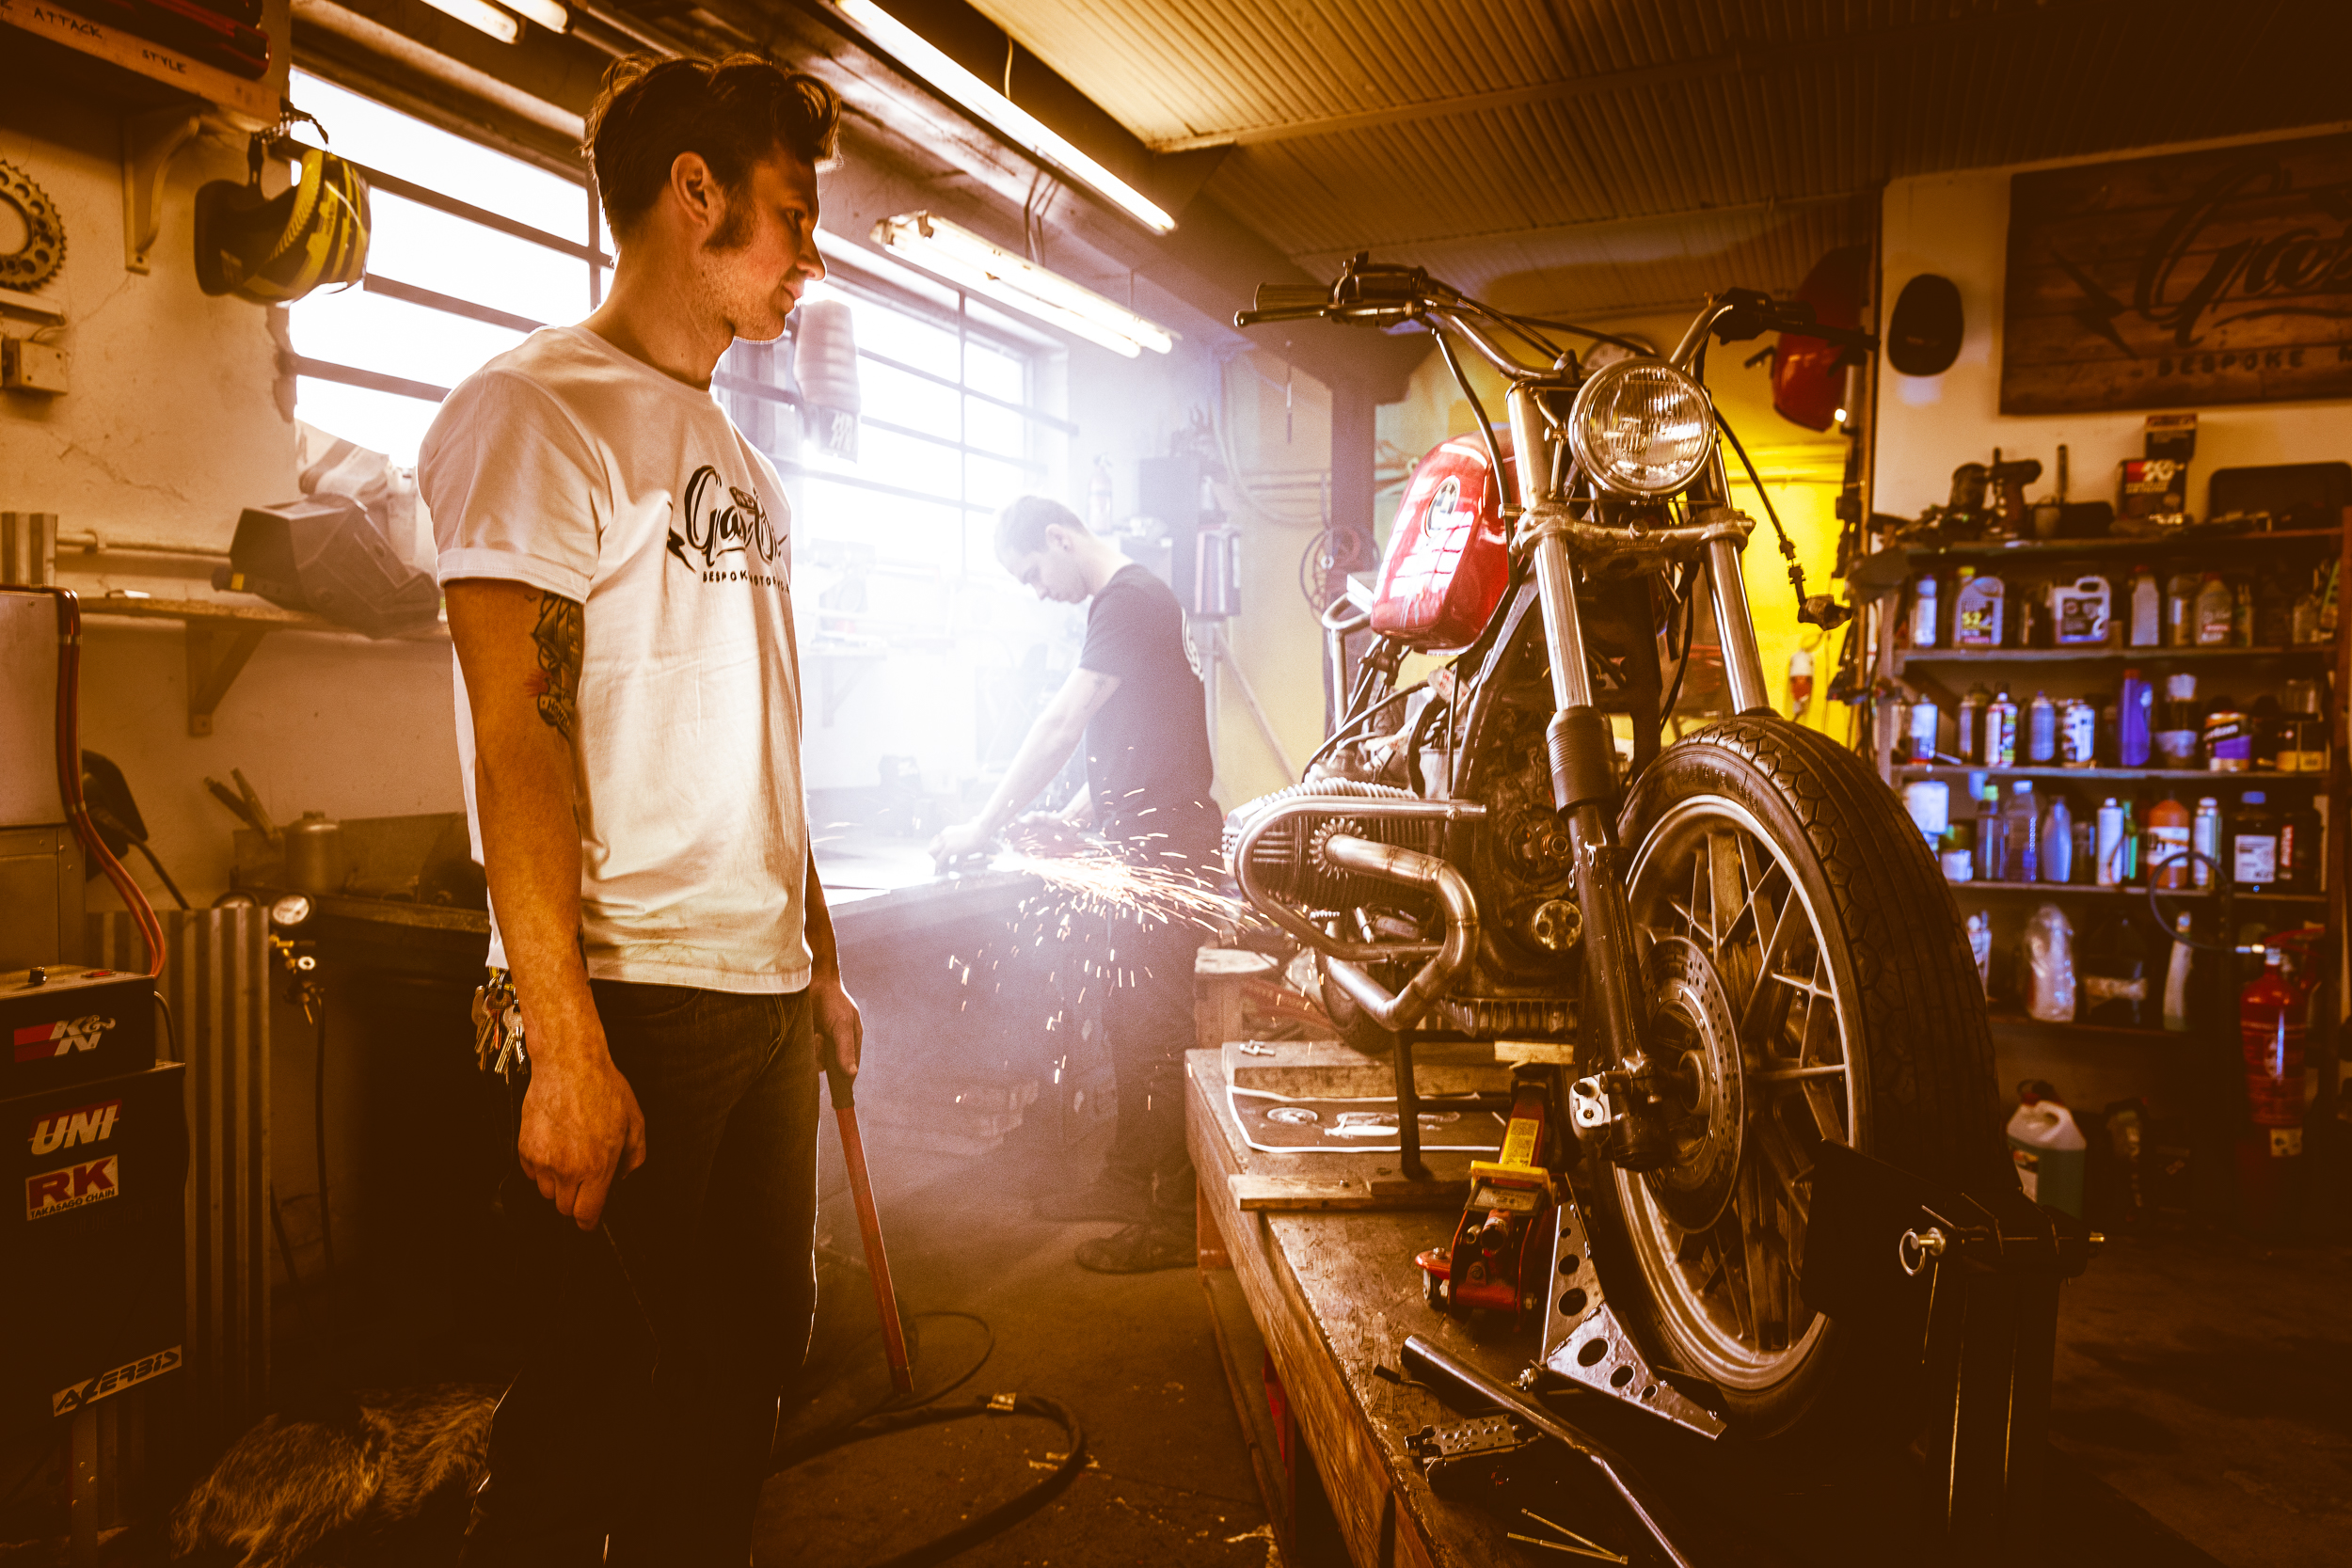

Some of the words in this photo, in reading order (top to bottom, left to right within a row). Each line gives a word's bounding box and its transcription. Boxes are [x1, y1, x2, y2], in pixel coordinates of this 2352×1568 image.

[34, 7, 103, 40] ATTACK
[141, 48, 187, 74] STYLE
[703, 570, 750, 584] BESPOK
[31, 1104, 119, 1155] UNI
[29, 1157, 115, 1211] RK
[30, 1197, 84, 1219] TAKASAGO
[86, 1187, 116, 1203] CHAIN
[56, 1351, 180, 1413] ACERBIS
